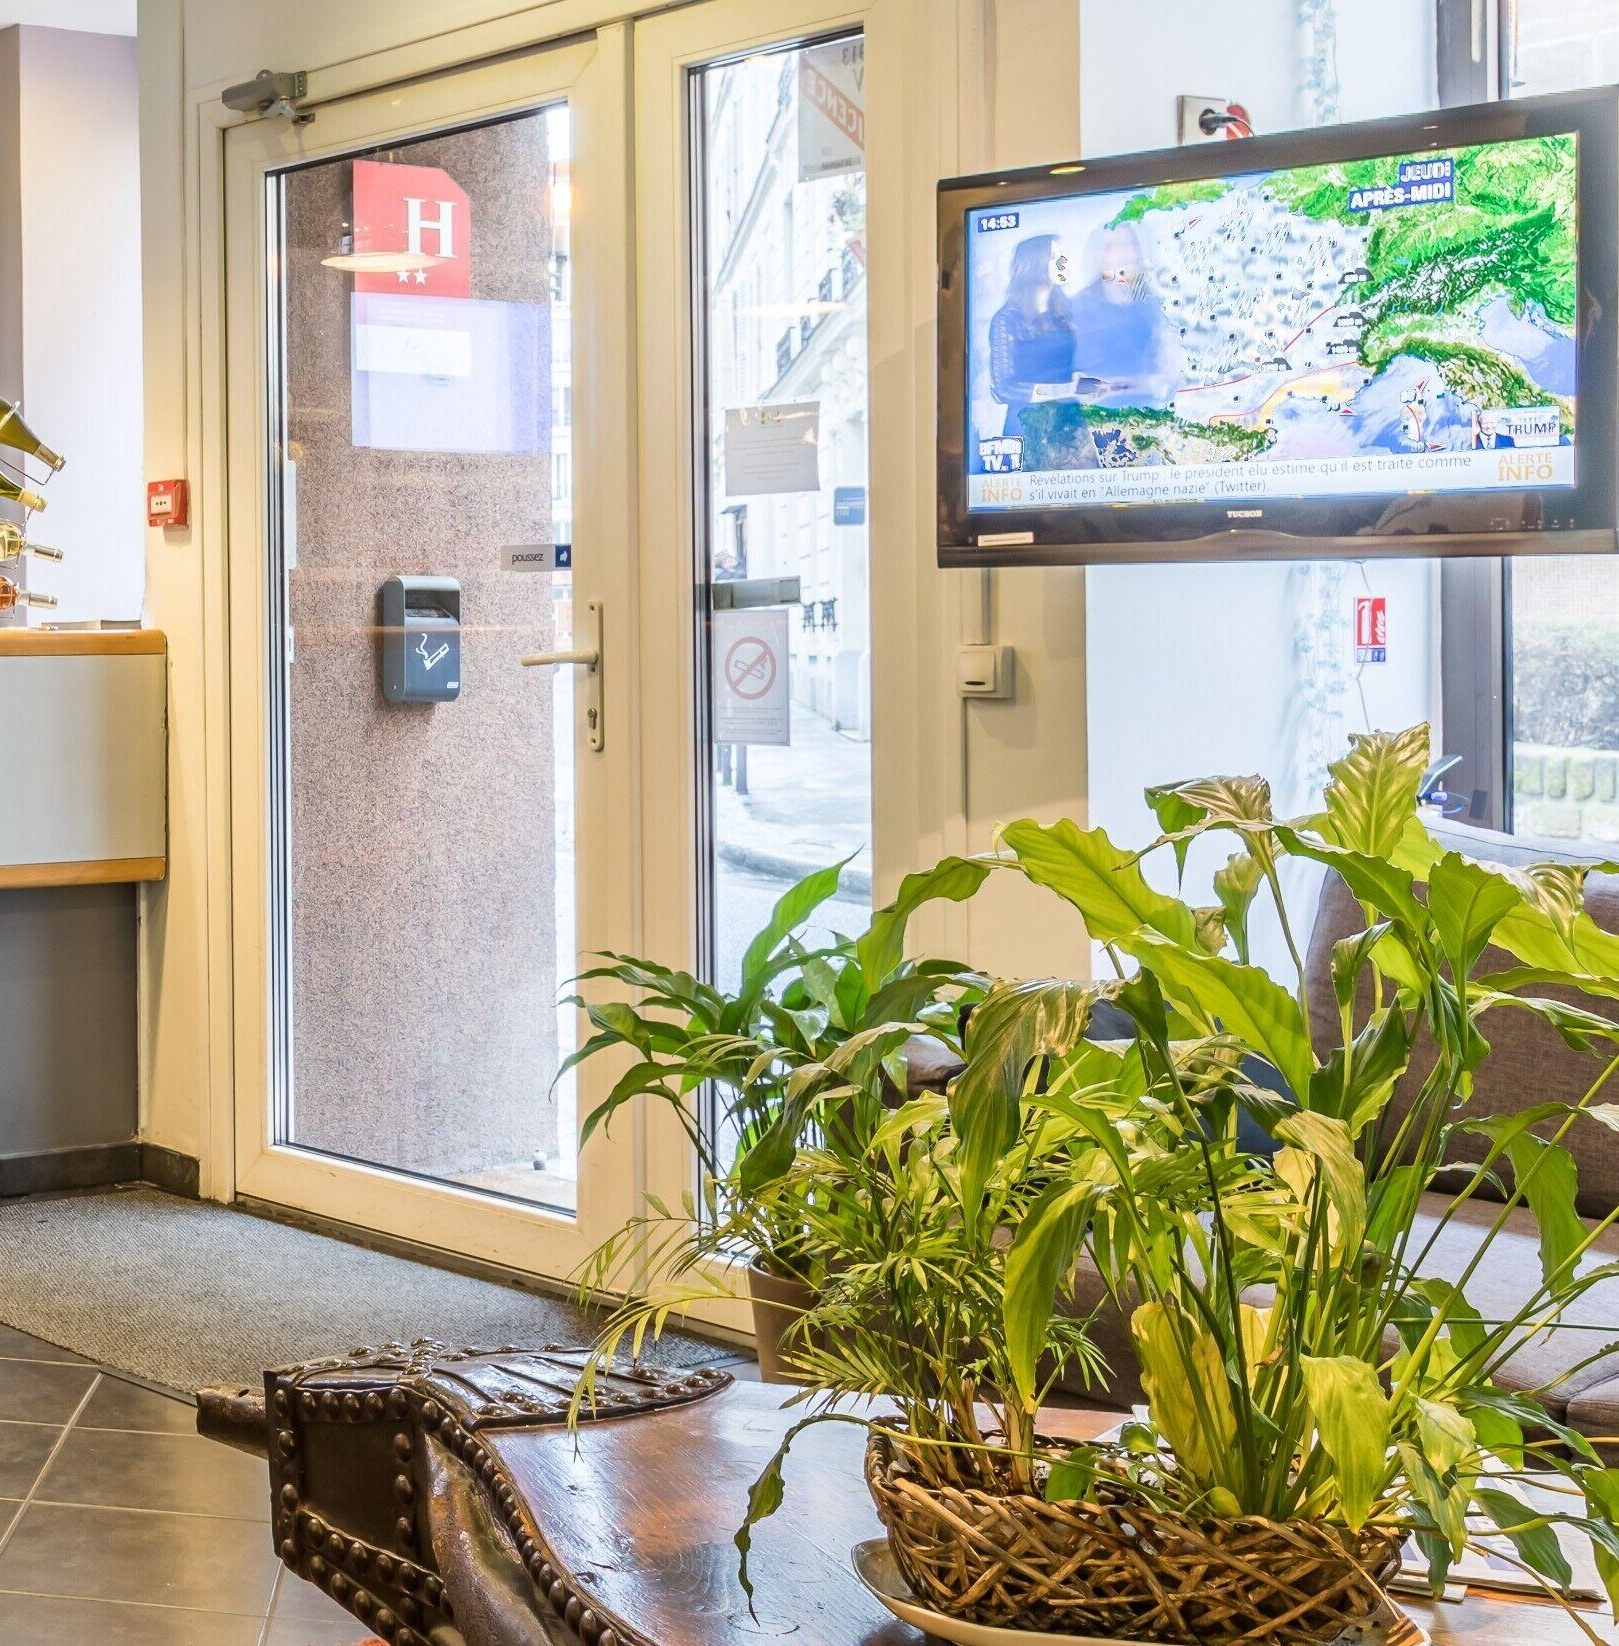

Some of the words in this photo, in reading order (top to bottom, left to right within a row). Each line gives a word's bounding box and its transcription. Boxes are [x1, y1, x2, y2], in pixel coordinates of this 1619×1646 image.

[1400, 161, 1451, 182] JEUDI
[1351, 182, 1451, 208] APRÈS-MIDI
[403, 197, 457, 258] H
[981, 215, 1016, 230] 14:53
[1499, 453, 1552, 464] ALERTE
[1030, 473, 1095, 486] Révélations
[1099, 473, 1116, 483] sur
[1122, 469, 1159, 484] Trump
[1170, 468, 1181, 479] le
[1272, 461, 1315, 476] estime
[1353, 458, 1373, 472] est
[1377, 455, 1413, 471] traité
[1417, 456, 1472, 469] comme
[1498, 464, 1553, 481] INFO
[982, 488, 1023, 502] INFO
[1048, 486, 1077, 499] vivait
[1081, 488, 1096, 498] en
[1214, 479, 1266, 495] (Twitter)
[512, 553, 543, 565] poussez
